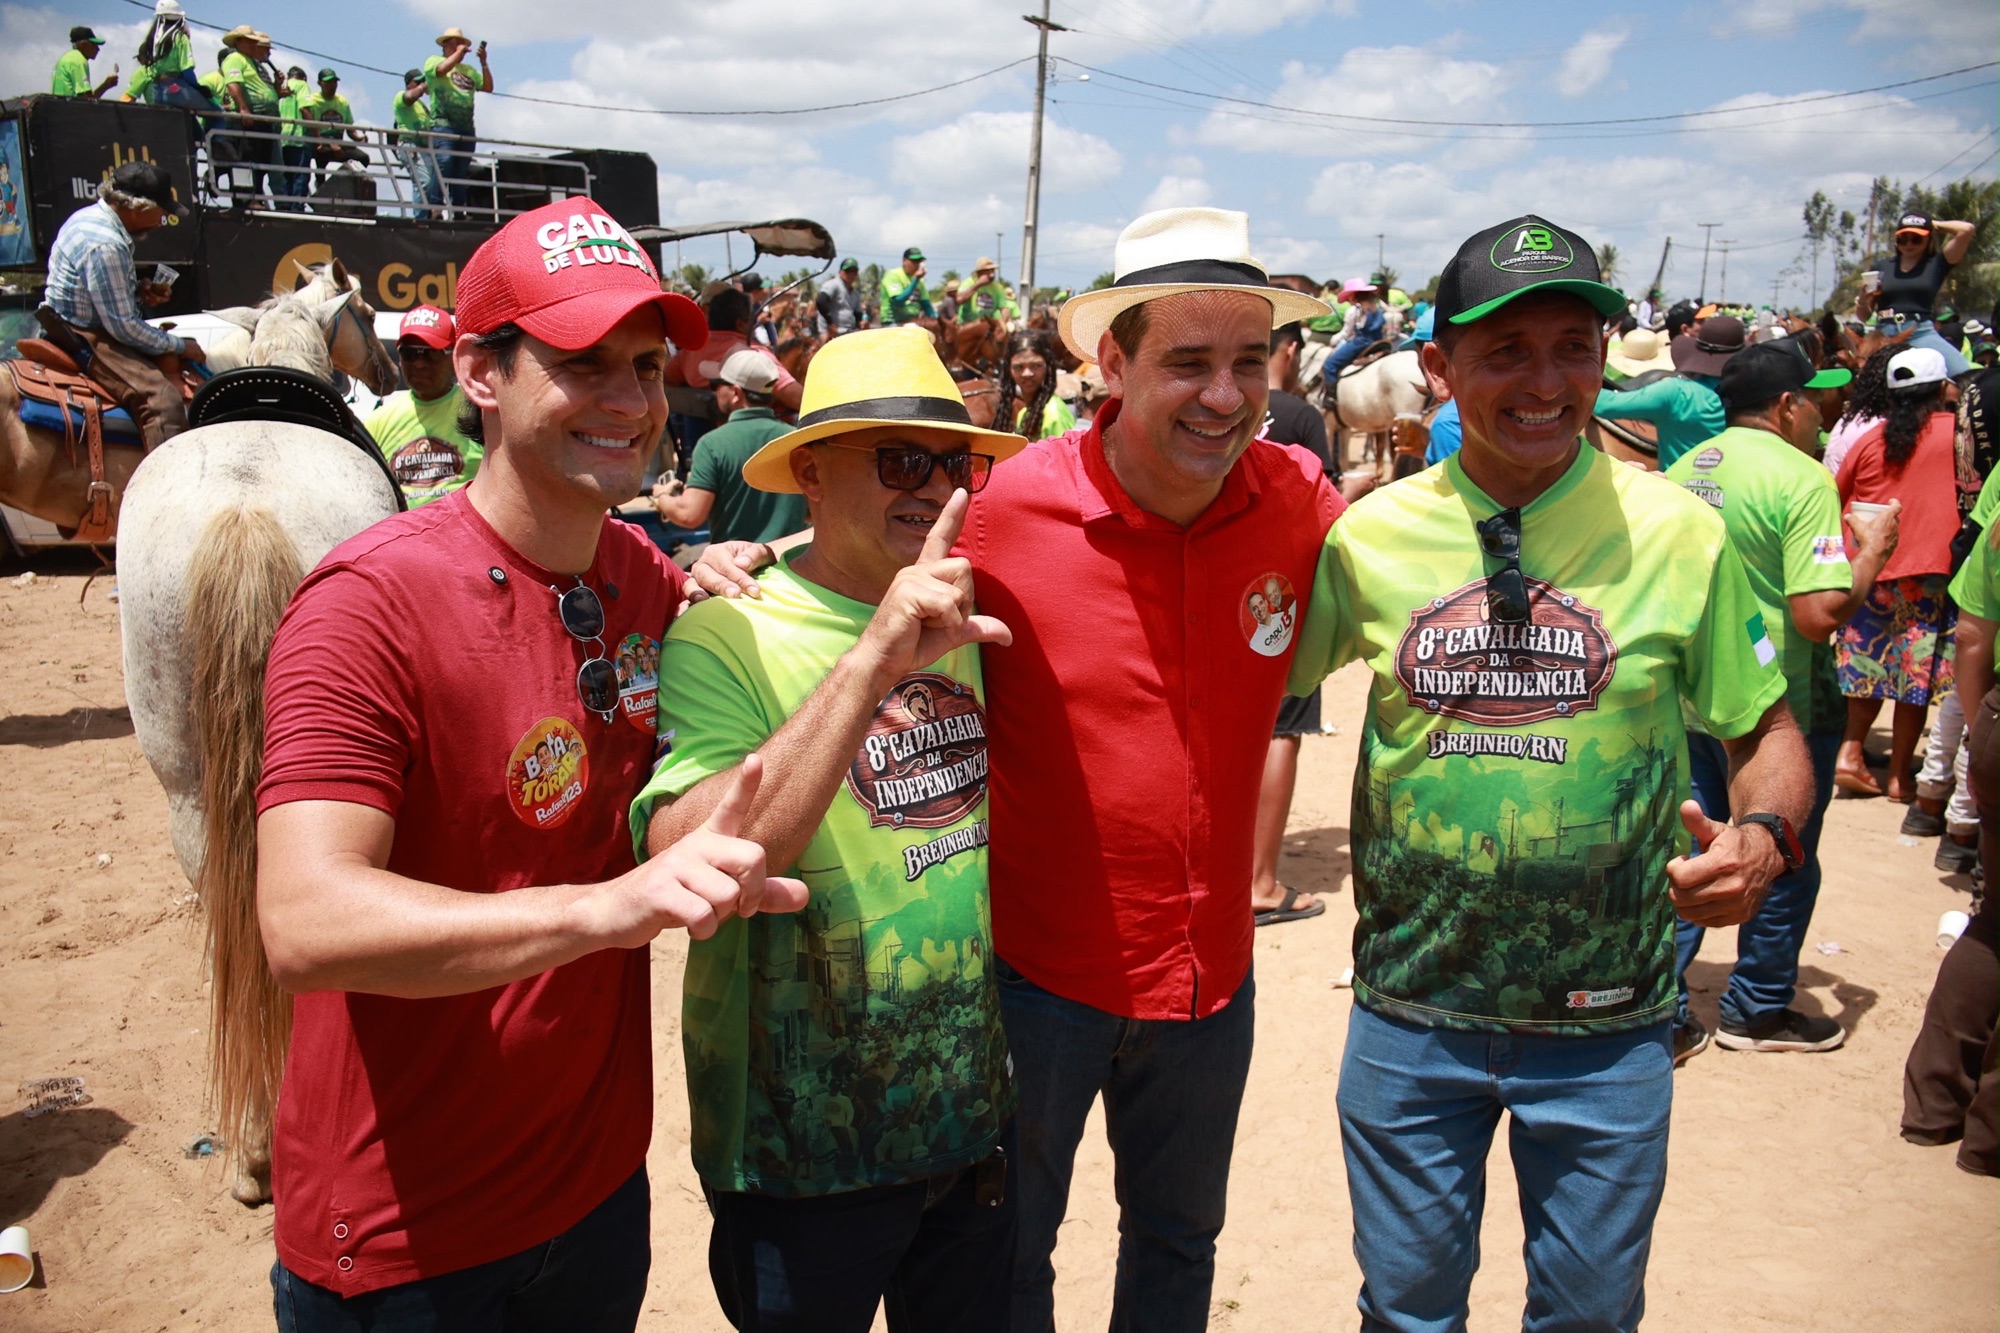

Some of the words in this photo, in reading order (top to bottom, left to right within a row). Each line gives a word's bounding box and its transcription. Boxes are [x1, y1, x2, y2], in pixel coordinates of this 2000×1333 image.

[1514, 229, 1554, 253] AB
[543, 252, 572, 275] DE
[1500, 255, 1530, 267] AGENOR
[1541, 254, 1569, 263] BARROS
[377, 262, 456, 309] Gal
[1973, 409, 1991, 450] DARK
[405, 453, 453, 465] CAVALGADA
[1264, 624, 1283, 646] CADU
[1445, 624, 1587, 659] CAVALGADA
[1489, 653, 1510, 667] DA
[1414, 667, 1588, 697] INDEPENDENCIA
[623, 692, 657, 713] Rafael
[888, 712, 986, 762] CAVALGADA
[1427, 730, 1567, 764] BREJINHO/RN
[525, 733, 567, 779] BTA
[926, 751, 943, 767] DA
[873, 748, 988, 809] INDEPENDENCIA
